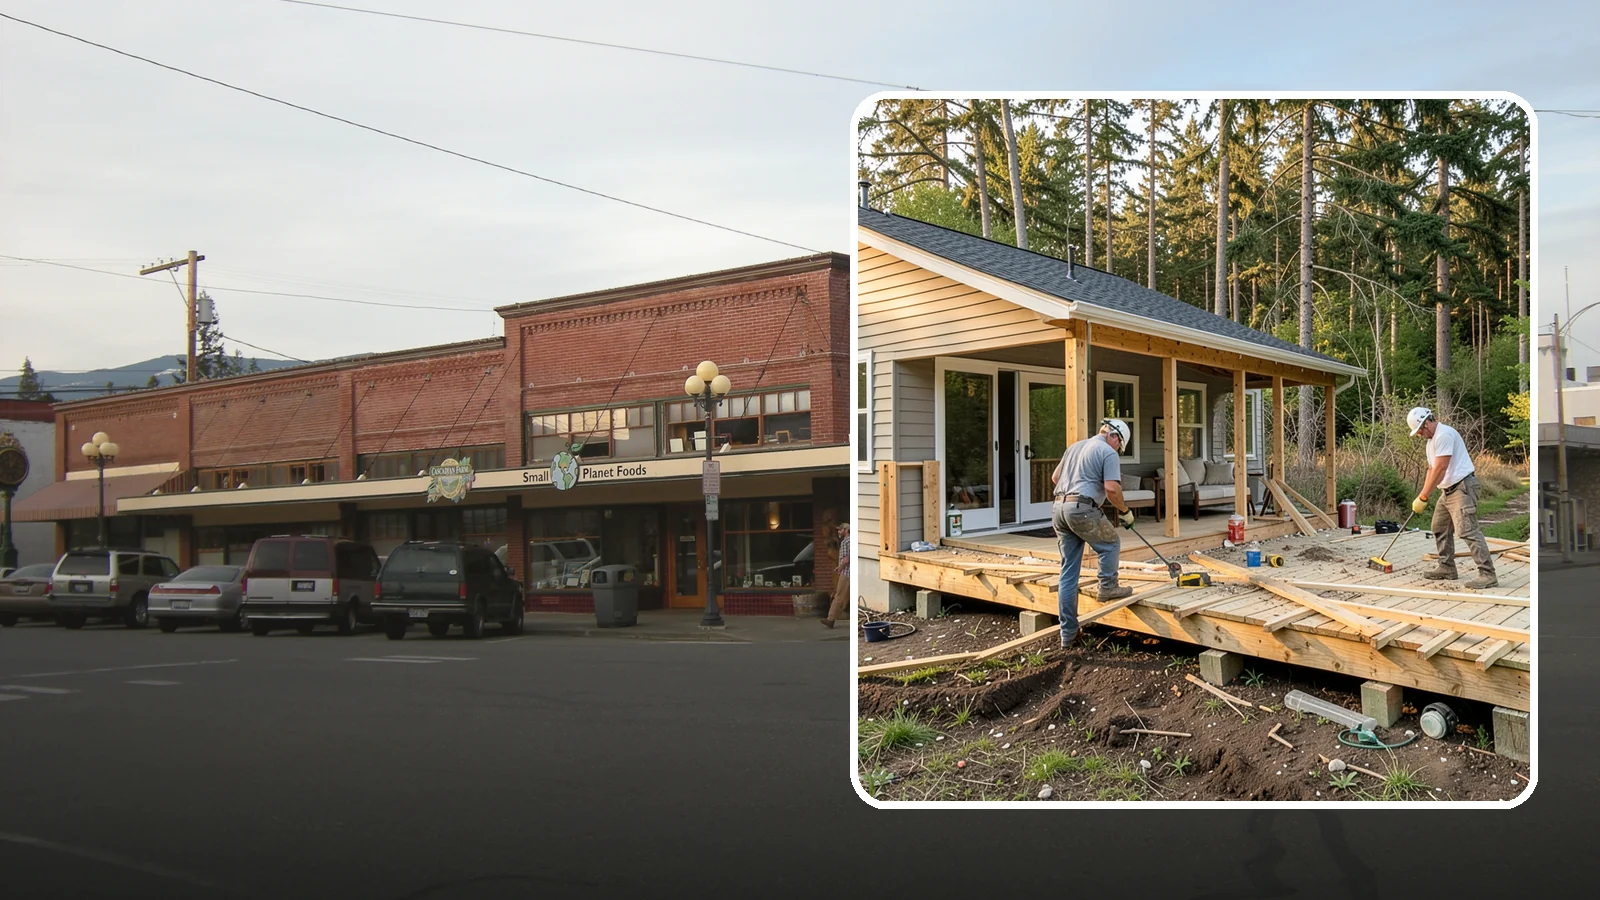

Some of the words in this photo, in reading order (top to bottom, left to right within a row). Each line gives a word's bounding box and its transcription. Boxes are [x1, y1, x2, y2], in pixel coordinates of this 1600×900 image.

[522, 470, 549, 483] Small
[582, 467, 614, 479] Planet
[616, 464, 647, 477] Foods
